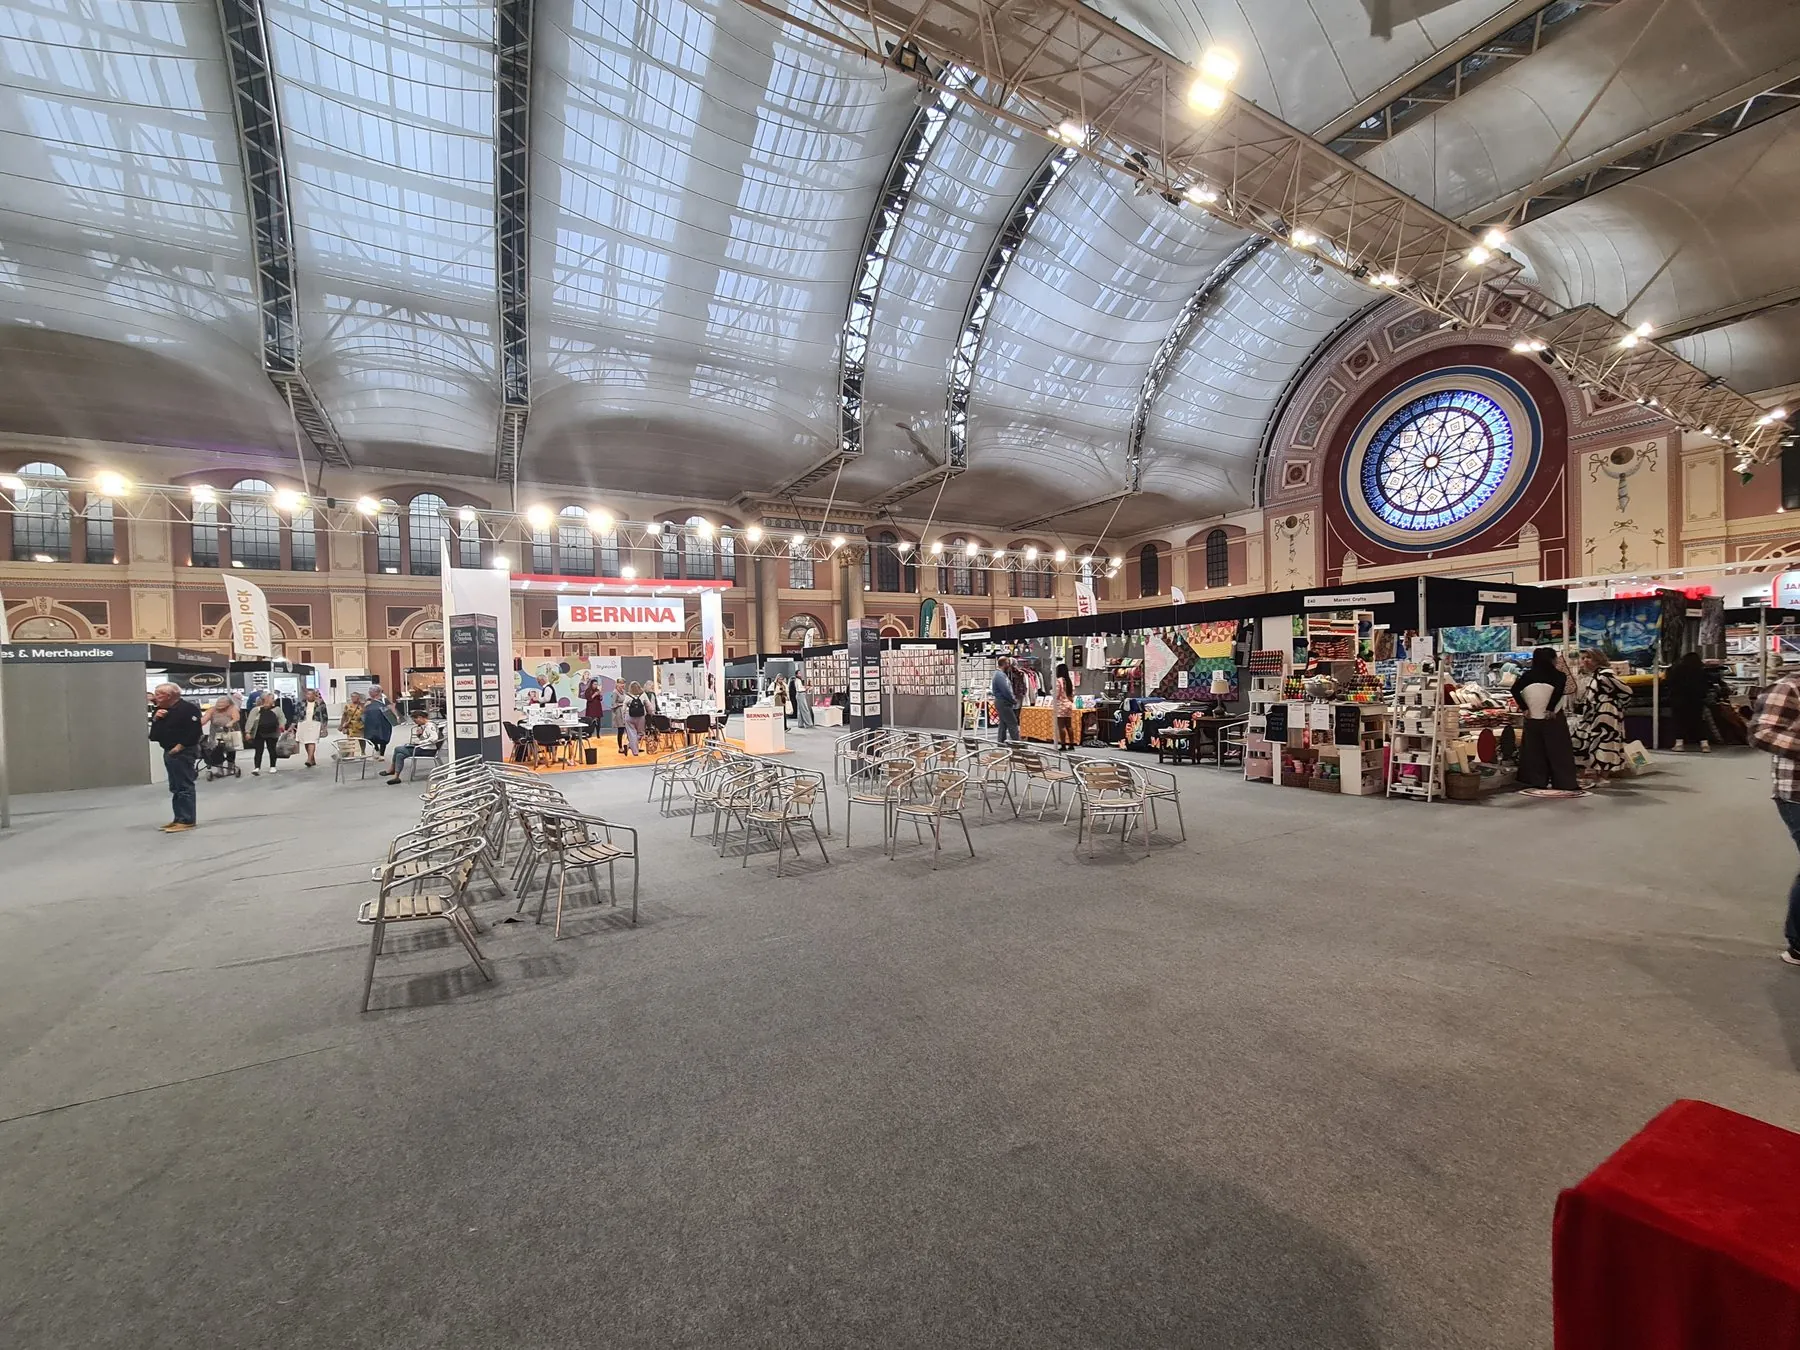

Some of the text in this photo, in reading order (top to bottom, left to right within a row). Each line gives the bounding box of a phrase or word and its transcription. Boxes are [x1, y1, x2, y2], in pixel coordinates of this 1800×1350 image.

[570, 605, 677, 623] BERNINA
[18, 649, 30, 658] &
[32, 648, 114, 658] Merchandise
